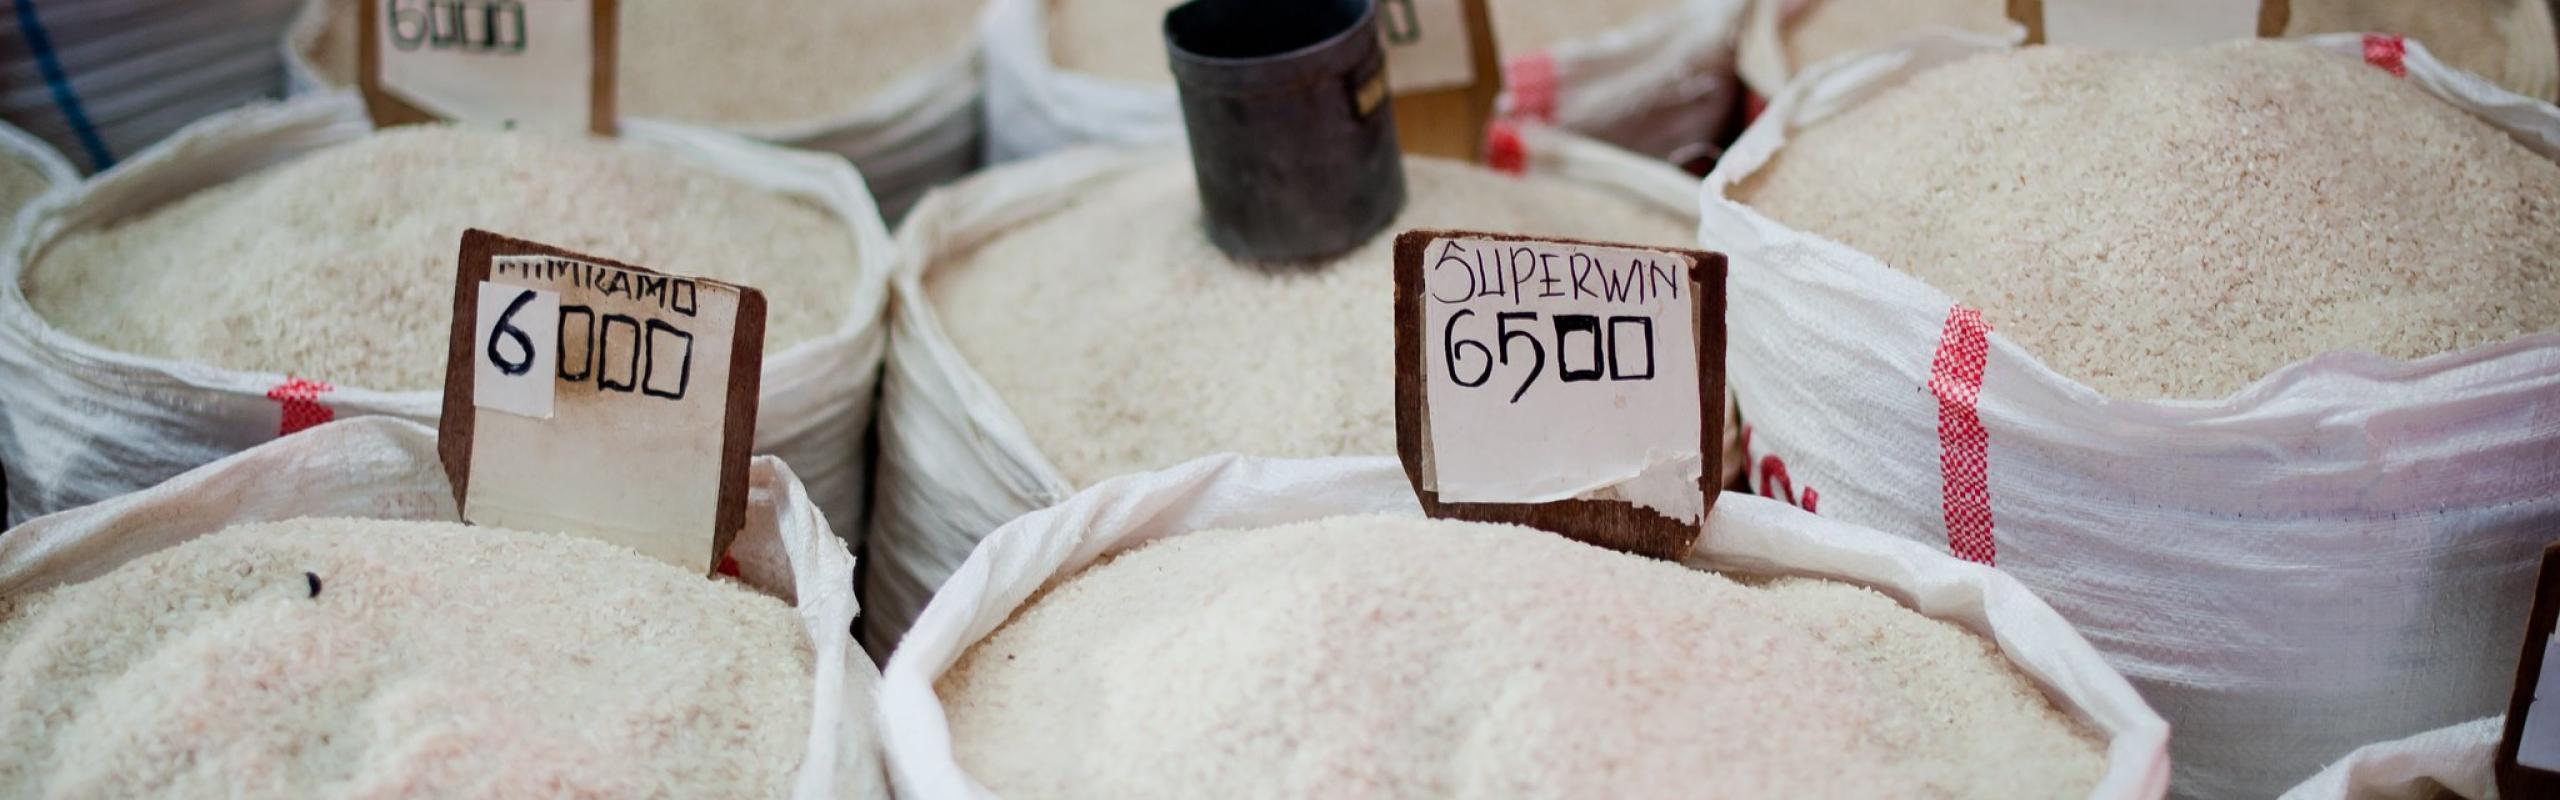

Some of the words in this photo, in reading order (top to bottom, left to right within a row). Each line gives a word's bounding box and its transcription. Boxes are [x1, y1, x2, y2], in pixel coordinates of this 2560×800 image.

[1433, 240, 1678, 305] SUPERWIN
[487, 289, 694, 400] 6000
[1444, 308, 1655, 404] 6500
